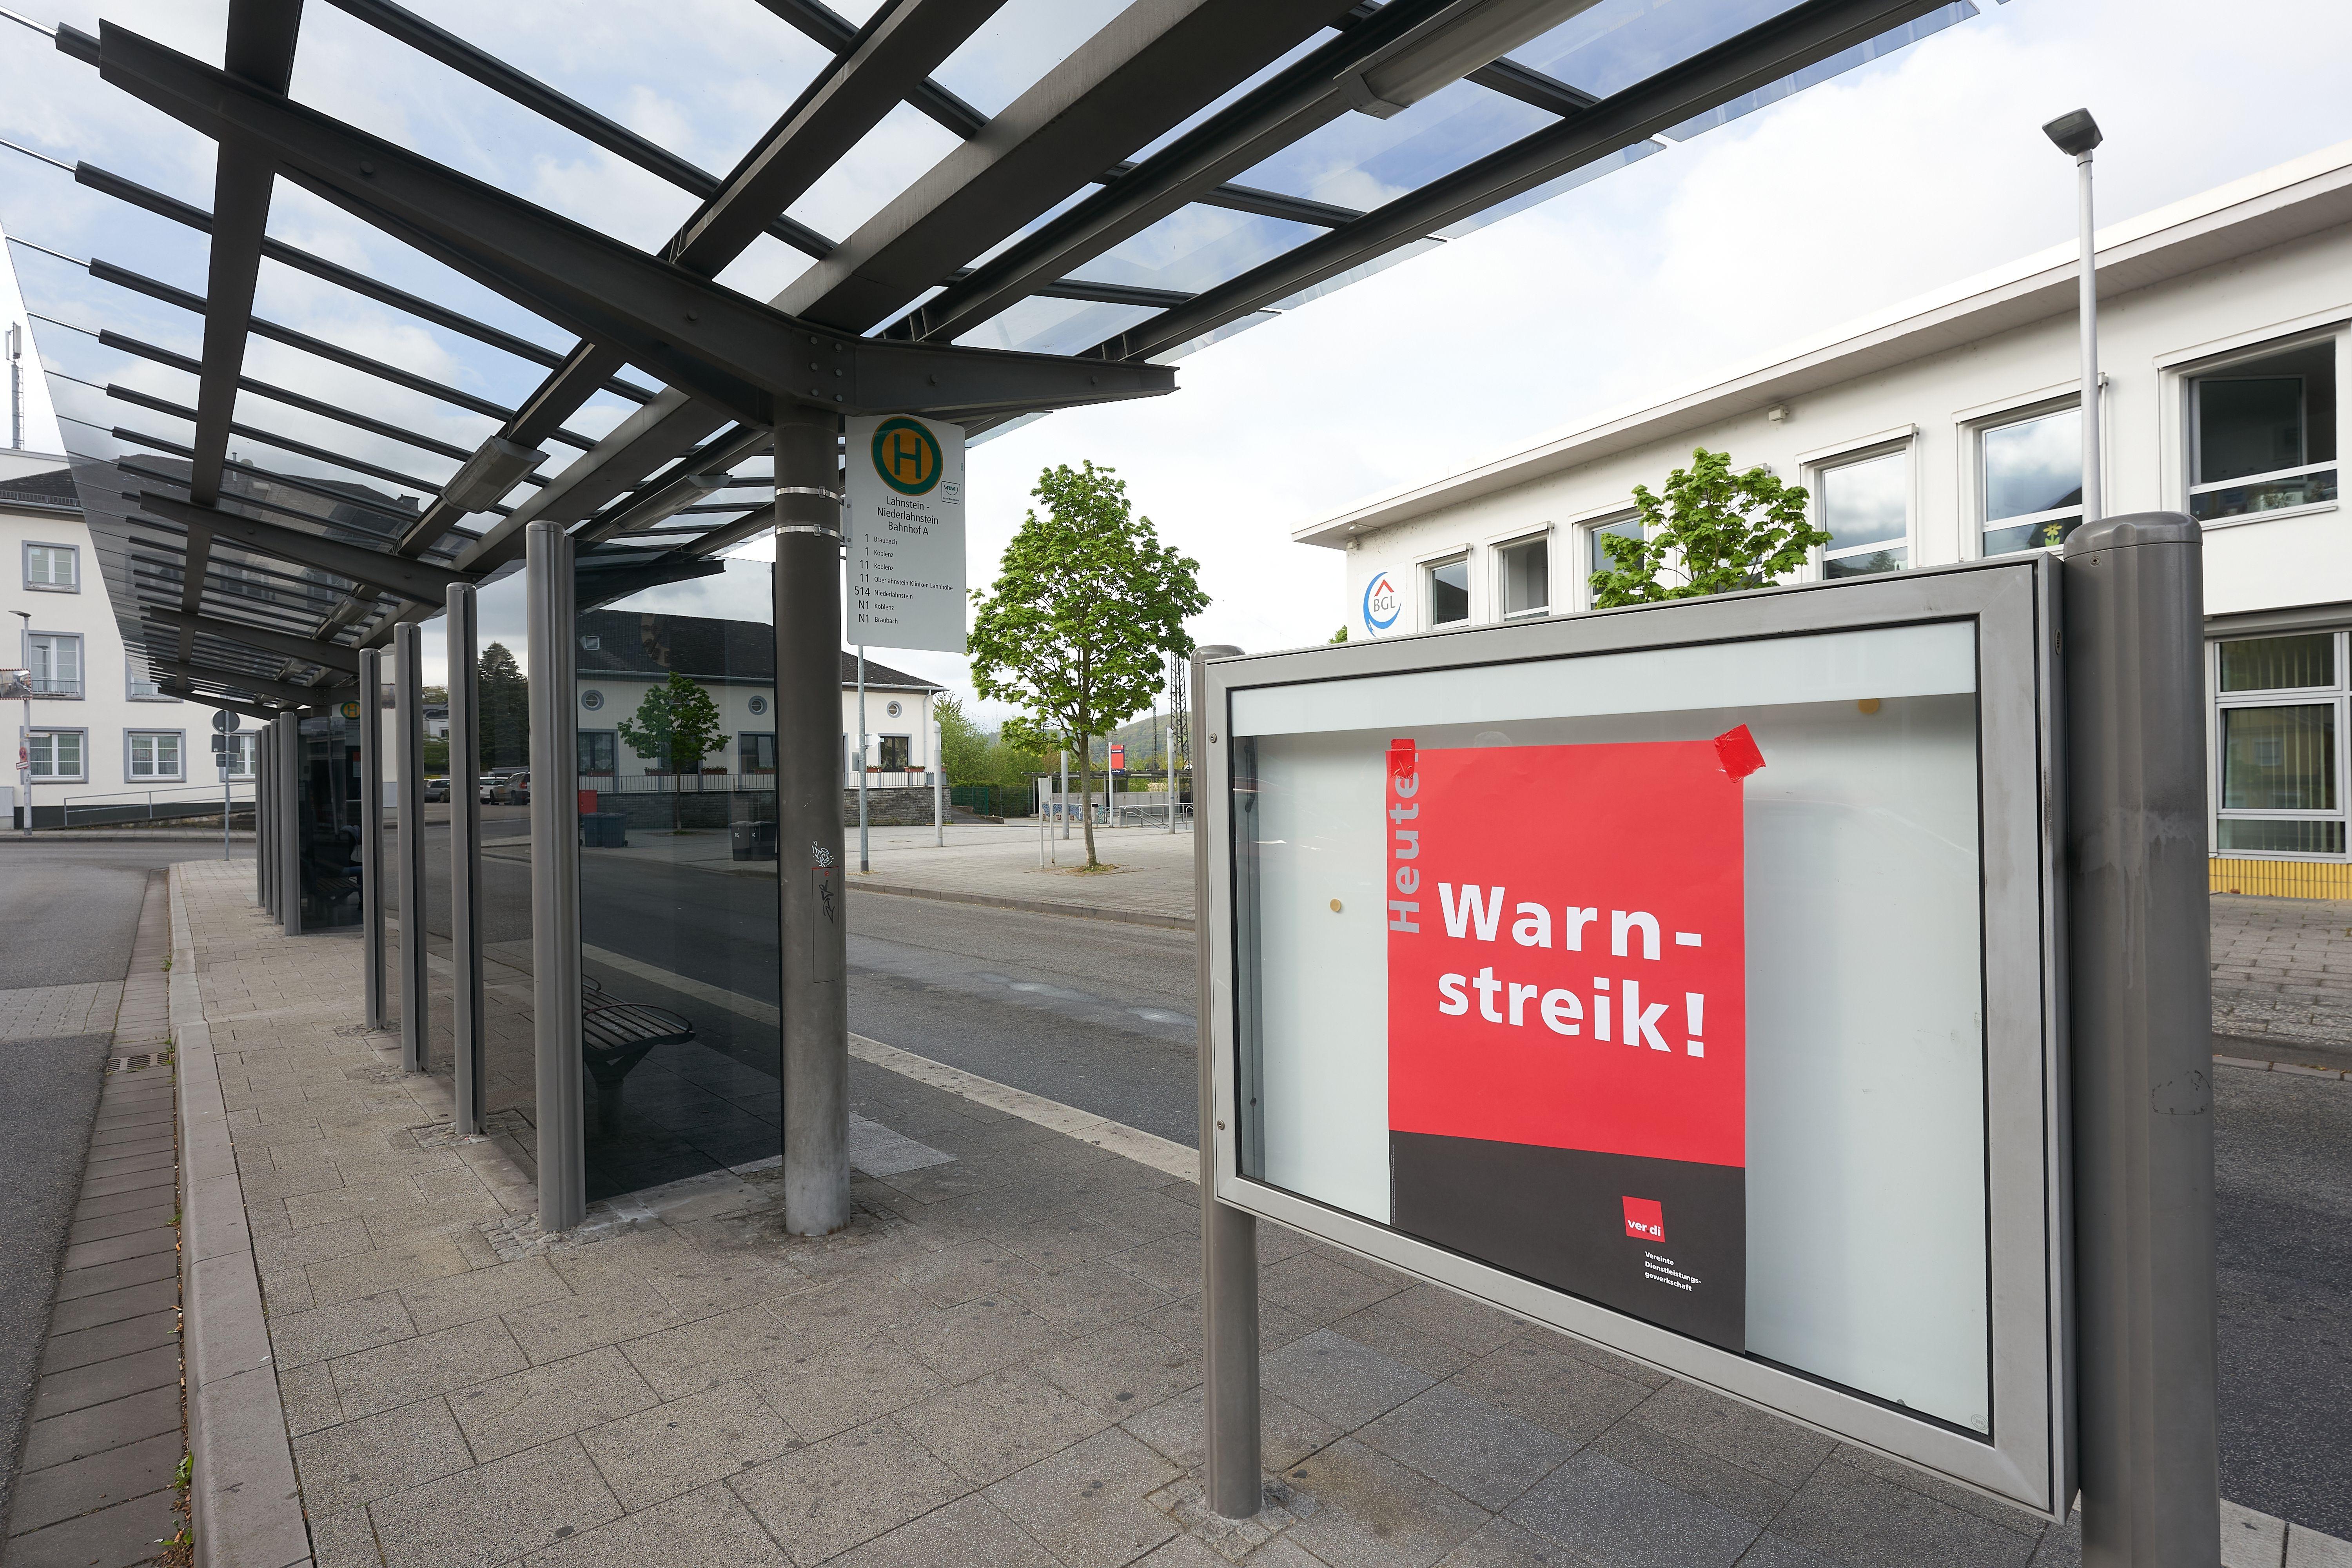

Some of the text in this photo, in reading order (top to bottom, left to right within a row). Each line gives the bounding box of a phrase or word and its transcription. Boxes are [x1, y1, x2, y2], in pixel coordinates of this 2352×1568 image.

[894, 433, 921, 479] H
[887, 496, 924, 510] Lahnstein
[877, 507, 938, 525] Niederlahnstein
[888, 521, 929, 535] Bahnhof A
[865, 534, 897, 545] 1 Braubach
[865, 547, 868, 556] 1
[860, 560, 868, 569] 11
[860, 573, 868, 583] 11
[874, 577, 909, 586] Oberlahnstein
[855, 586, 913, 599] 514 Niederlahnstein
[859, 600, 869, 610] N1
[1374, 596, 1396, 612] BGL
[859, 614, 869, 623] N1
[1437, 882, 1702, 960] Warn-
[1438, 967, 1704, 1058] streik!
[1627, 1220, 1661, 1237] ver.di
[1645, 1251, 1674, 1266] Vereinte
[1645, 1261, 1701, 1284] Dienstleistungs-
[1644, 1272, 1692, 1292] gewerkschaft
